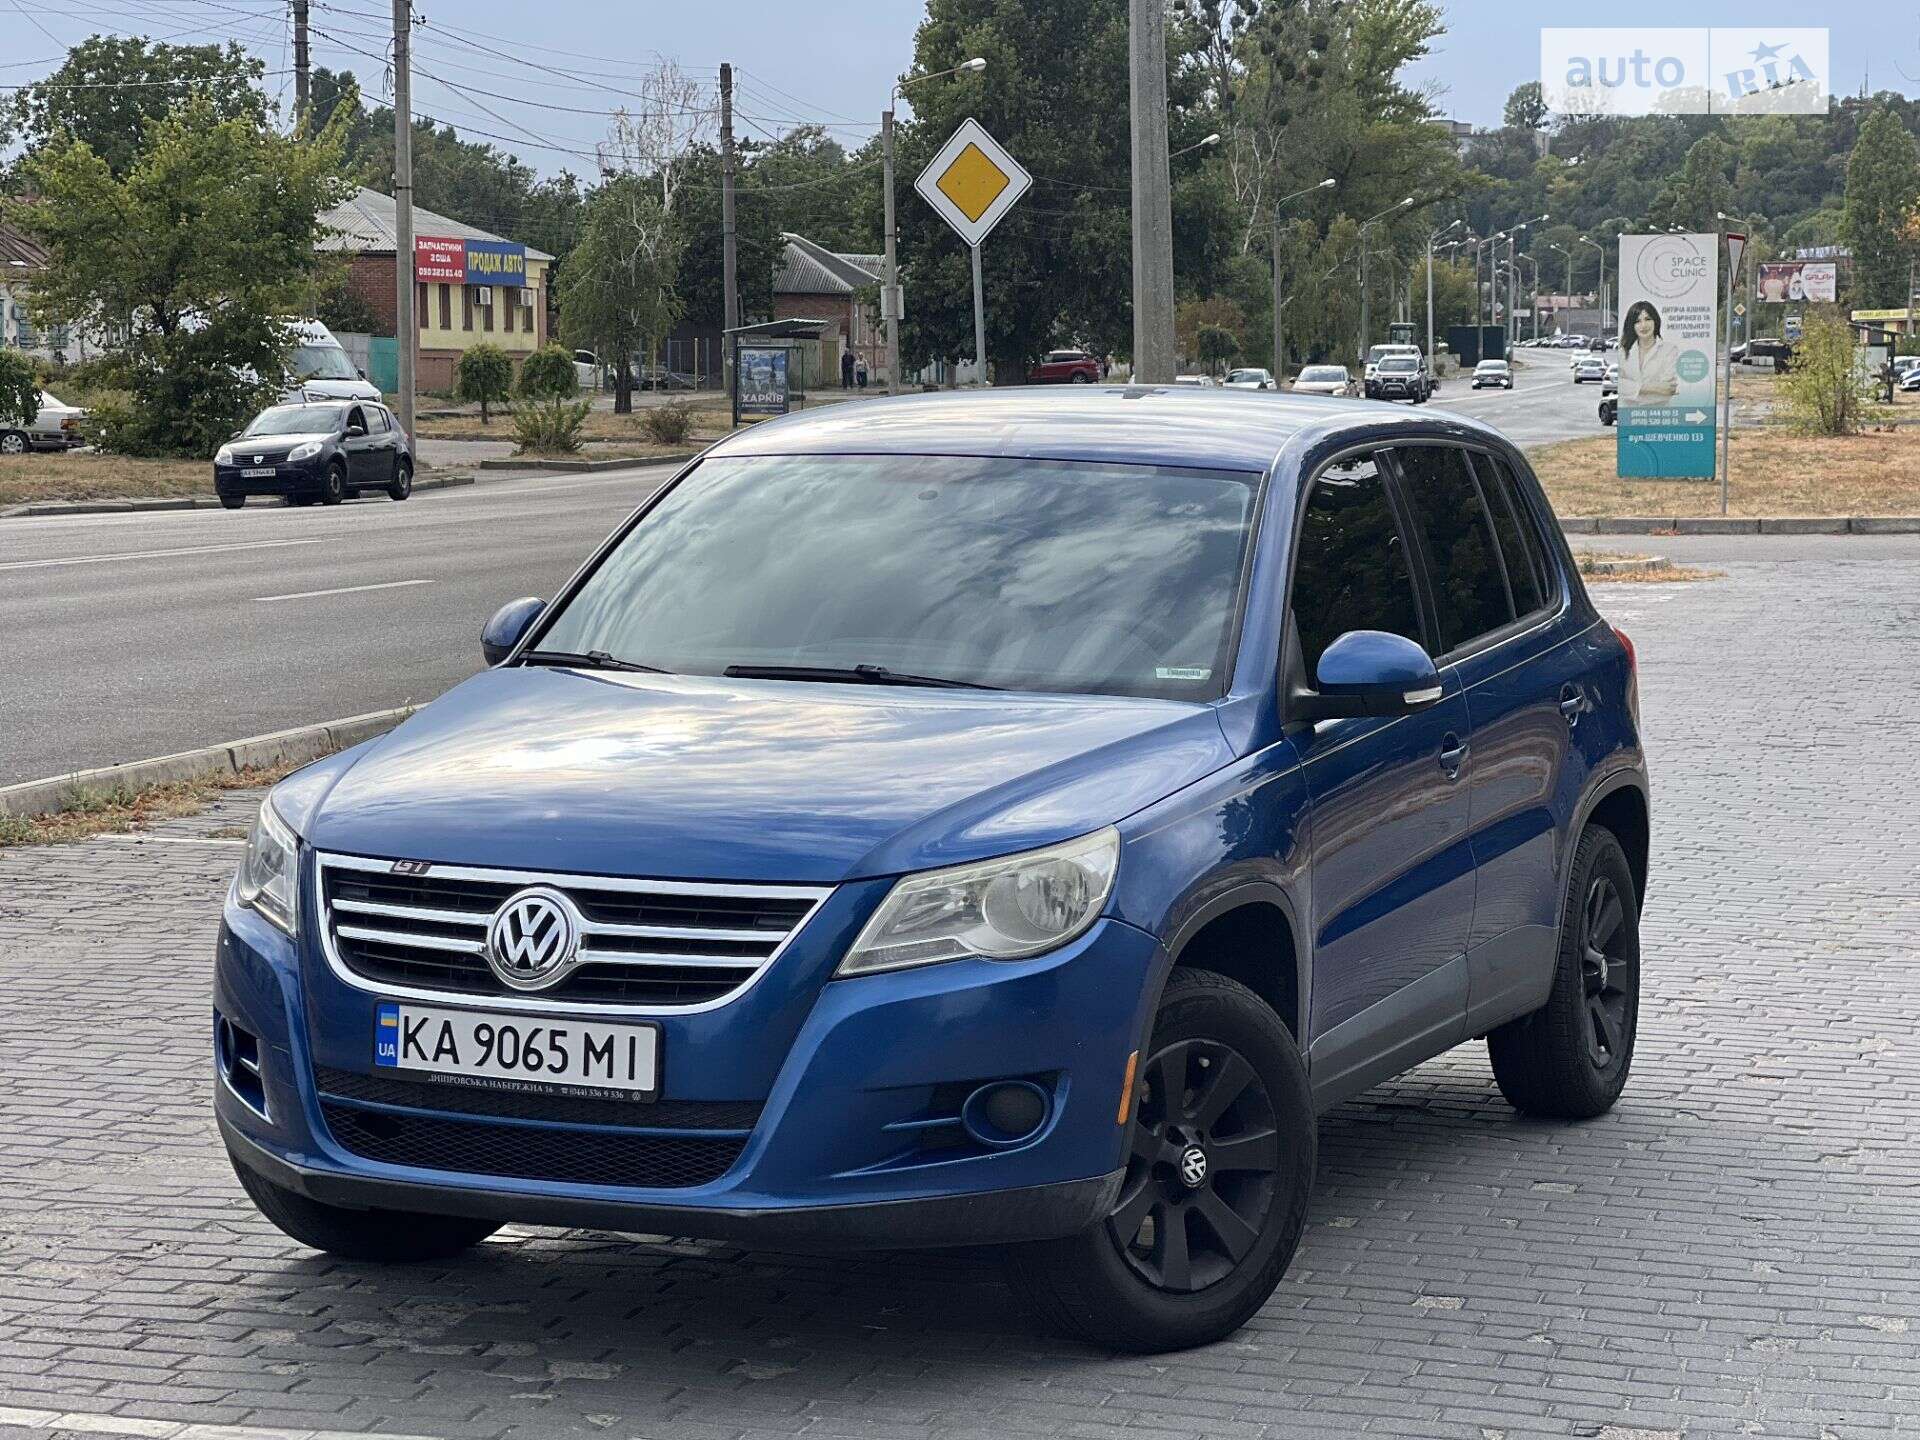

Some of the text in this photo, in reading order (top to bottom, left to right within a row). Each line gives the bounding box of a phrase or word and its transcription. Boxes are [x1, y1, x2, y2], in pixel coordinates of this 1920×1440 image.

[418, 241, 462, 252] ЗАПЧАСТИНИ
[468, 251, 523, 276] ПРОДАЖ АВТО
[1671, 256, 1707, 267] SPACE
[1671, 267, 1707, 278] CLINIC
[742, 393, 784, 403] ХАРКІВ
[1691, 432, 1704, 442] 133
[378, 1043, 396, 1057] UA
[402, 1015, 637, 1081] KA 9065 MI
